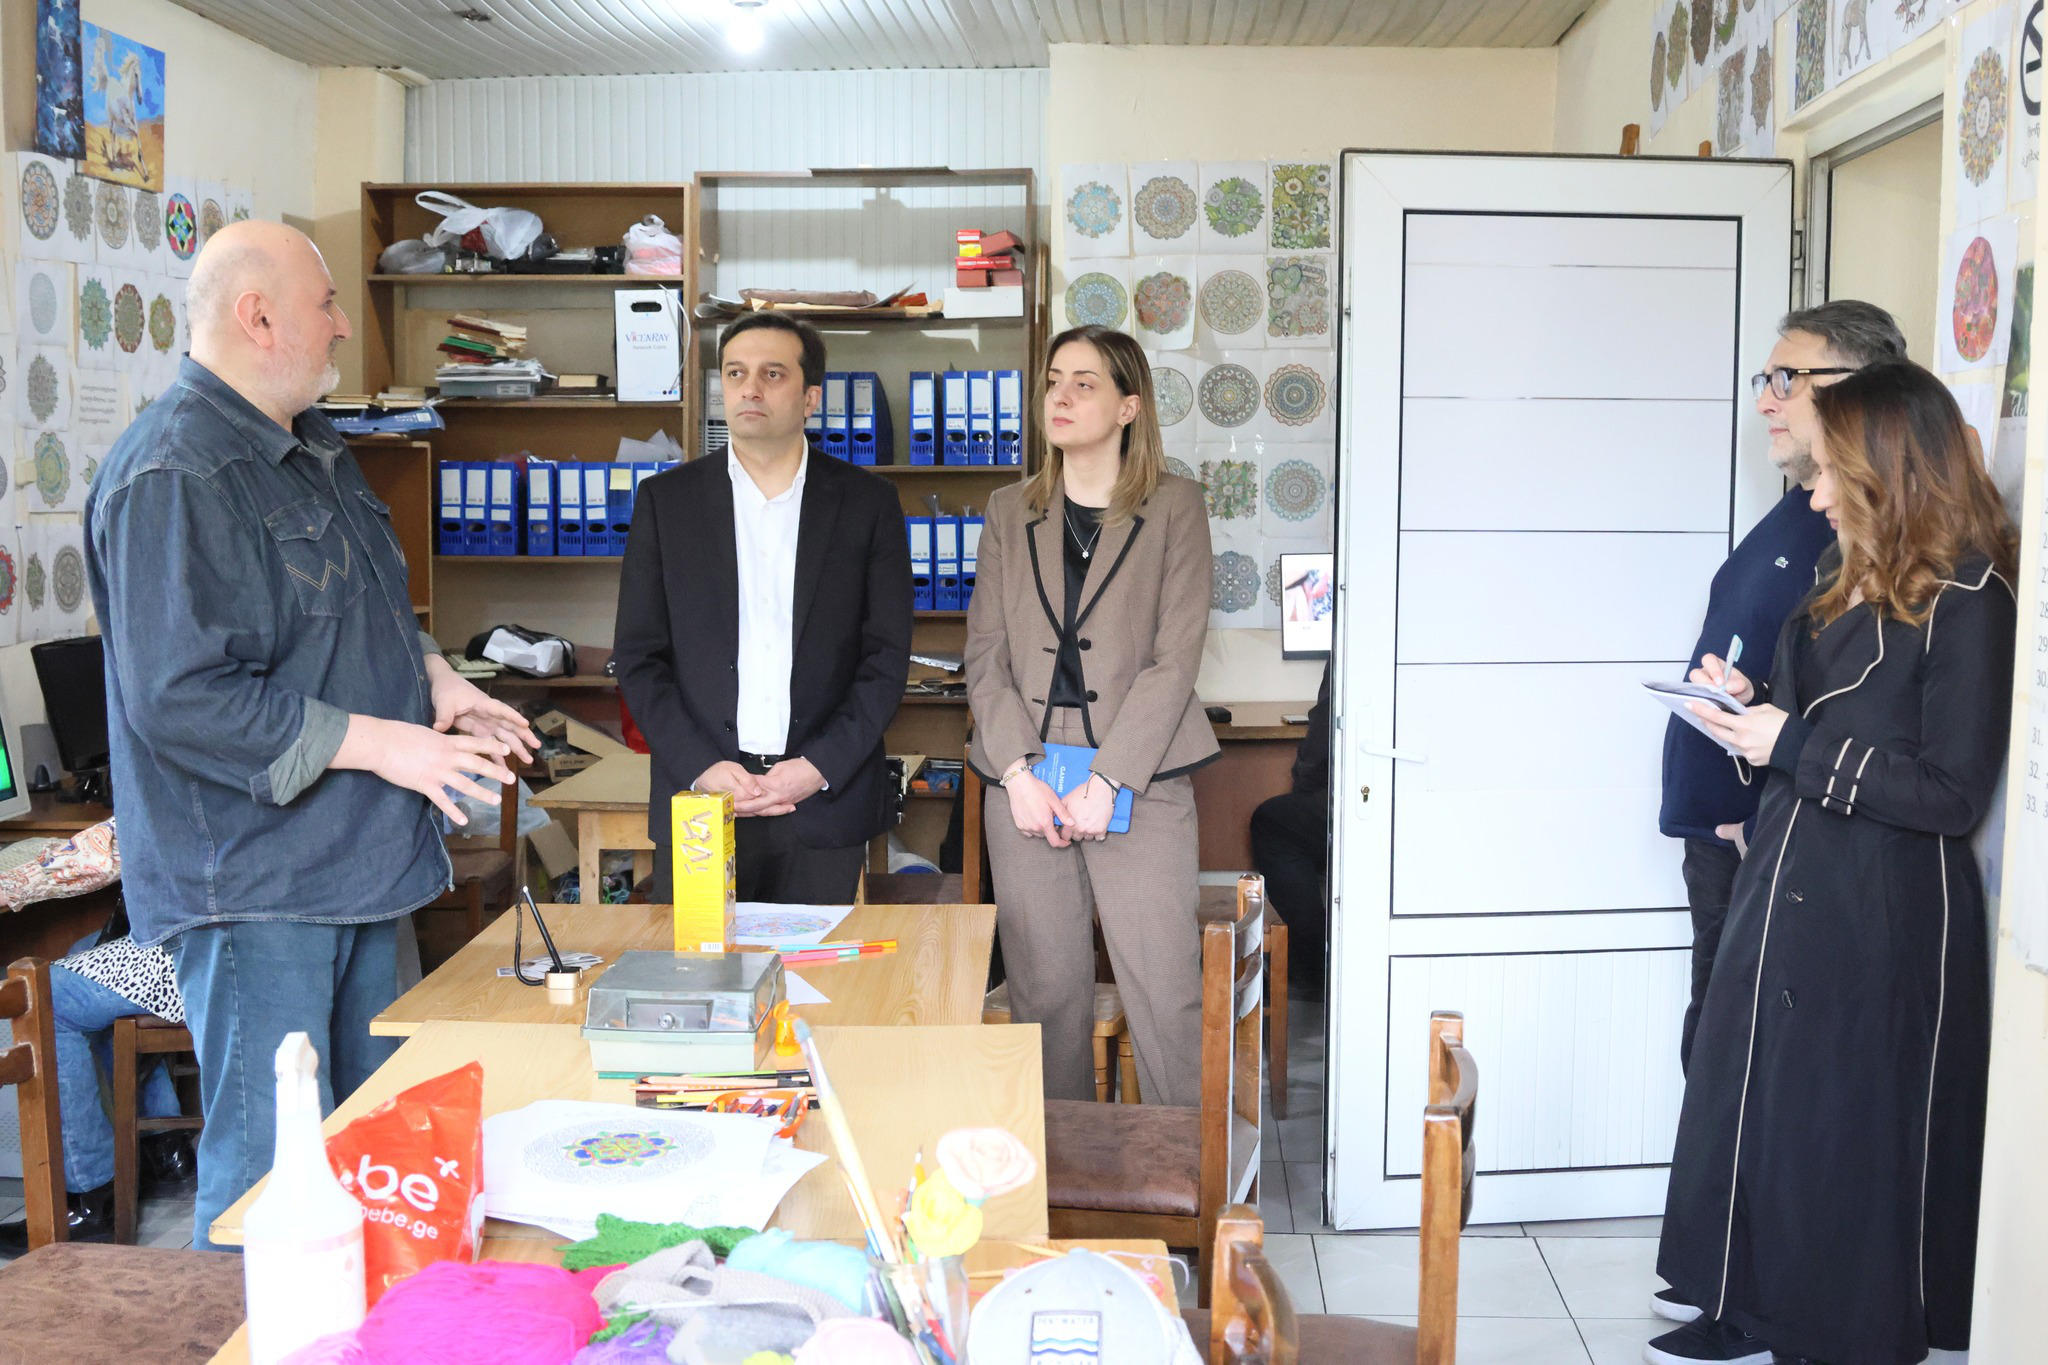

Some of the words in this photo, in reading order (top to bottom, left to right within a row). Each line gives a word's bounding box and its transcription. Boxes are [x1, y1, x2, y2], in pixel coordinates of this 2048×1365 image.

[2032, 727, 2043, 747] 31.
[2028, 760, 2040, 780] 32.
[2026, 793, 2038, 814] 33.
[340, 1154, 439, 1212] be
